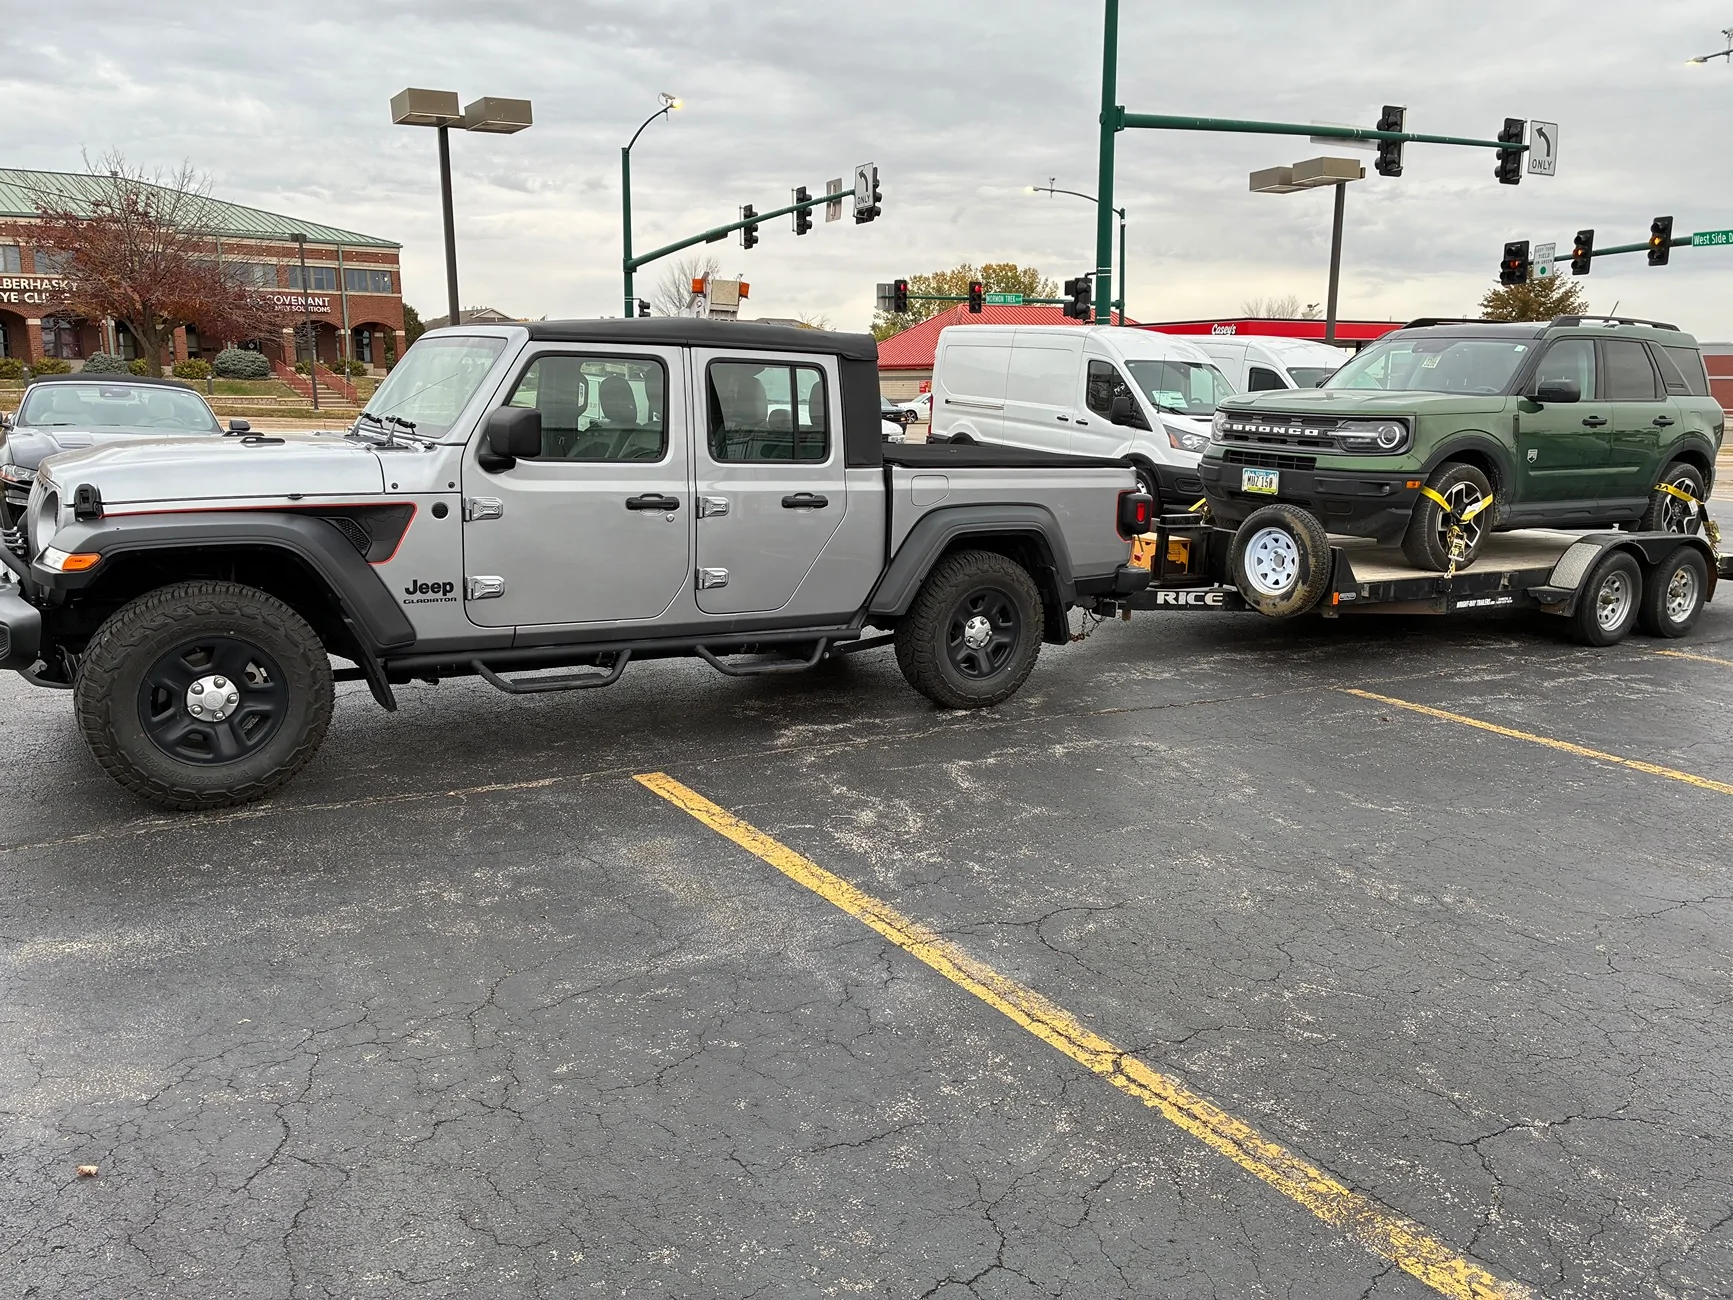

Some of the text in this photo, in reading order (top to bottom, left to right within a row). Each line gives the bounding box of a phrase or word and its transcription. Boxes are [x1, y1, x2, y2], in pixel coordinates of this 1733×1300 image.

[1531, 158, 1553, 171] ONLY
[857, 194, 871, 205] ONLY
[1693, 234, 1710, 245] West
[1711, 233, 1727, 244] Side
[1005, 295, 1016, 303] TREK
[1211, 323, 1237, 335] Casey's
[1232, 424, 1319, 436] BRONCO
[405, 579, 454, 596] Jeep
[403, 597, 458, 605] GLADIATOR
[1156, 591, 1224, 606] RICE
